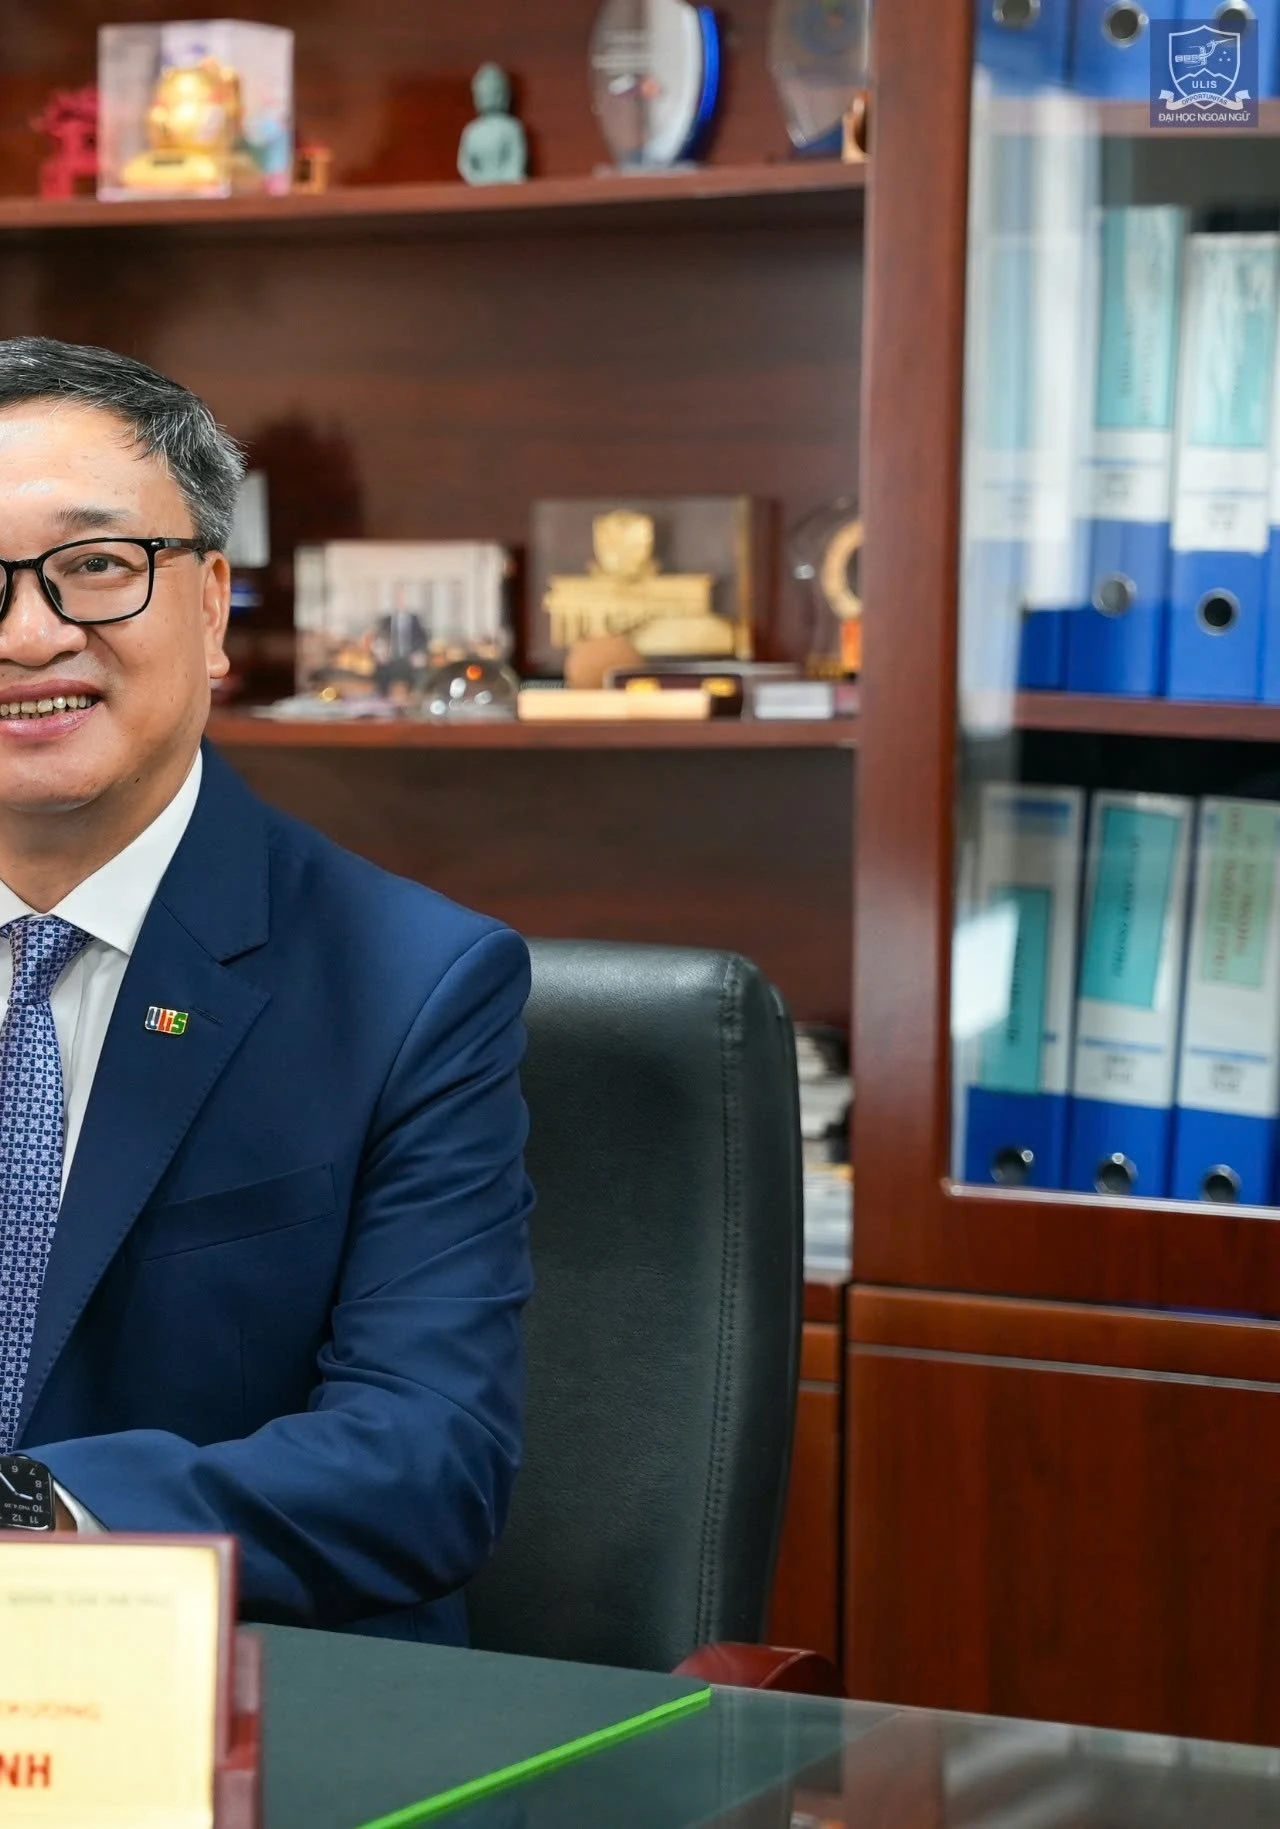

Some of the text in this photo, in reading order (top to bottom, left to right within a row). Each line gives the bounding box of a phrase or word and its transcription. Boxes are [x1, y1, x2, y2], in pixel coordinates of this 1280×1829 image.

[11, 1465, 19, 1473] 6
[29, 1468, 36, 1476] 7
[35, 1480, 42, 1488] 8
[36, 1493, 43, 1501] 9
[32, 1504, 43, 1512] 10
[12, 1514, 23, 1522] 12
[29, 1516, 39, 1524] 11
